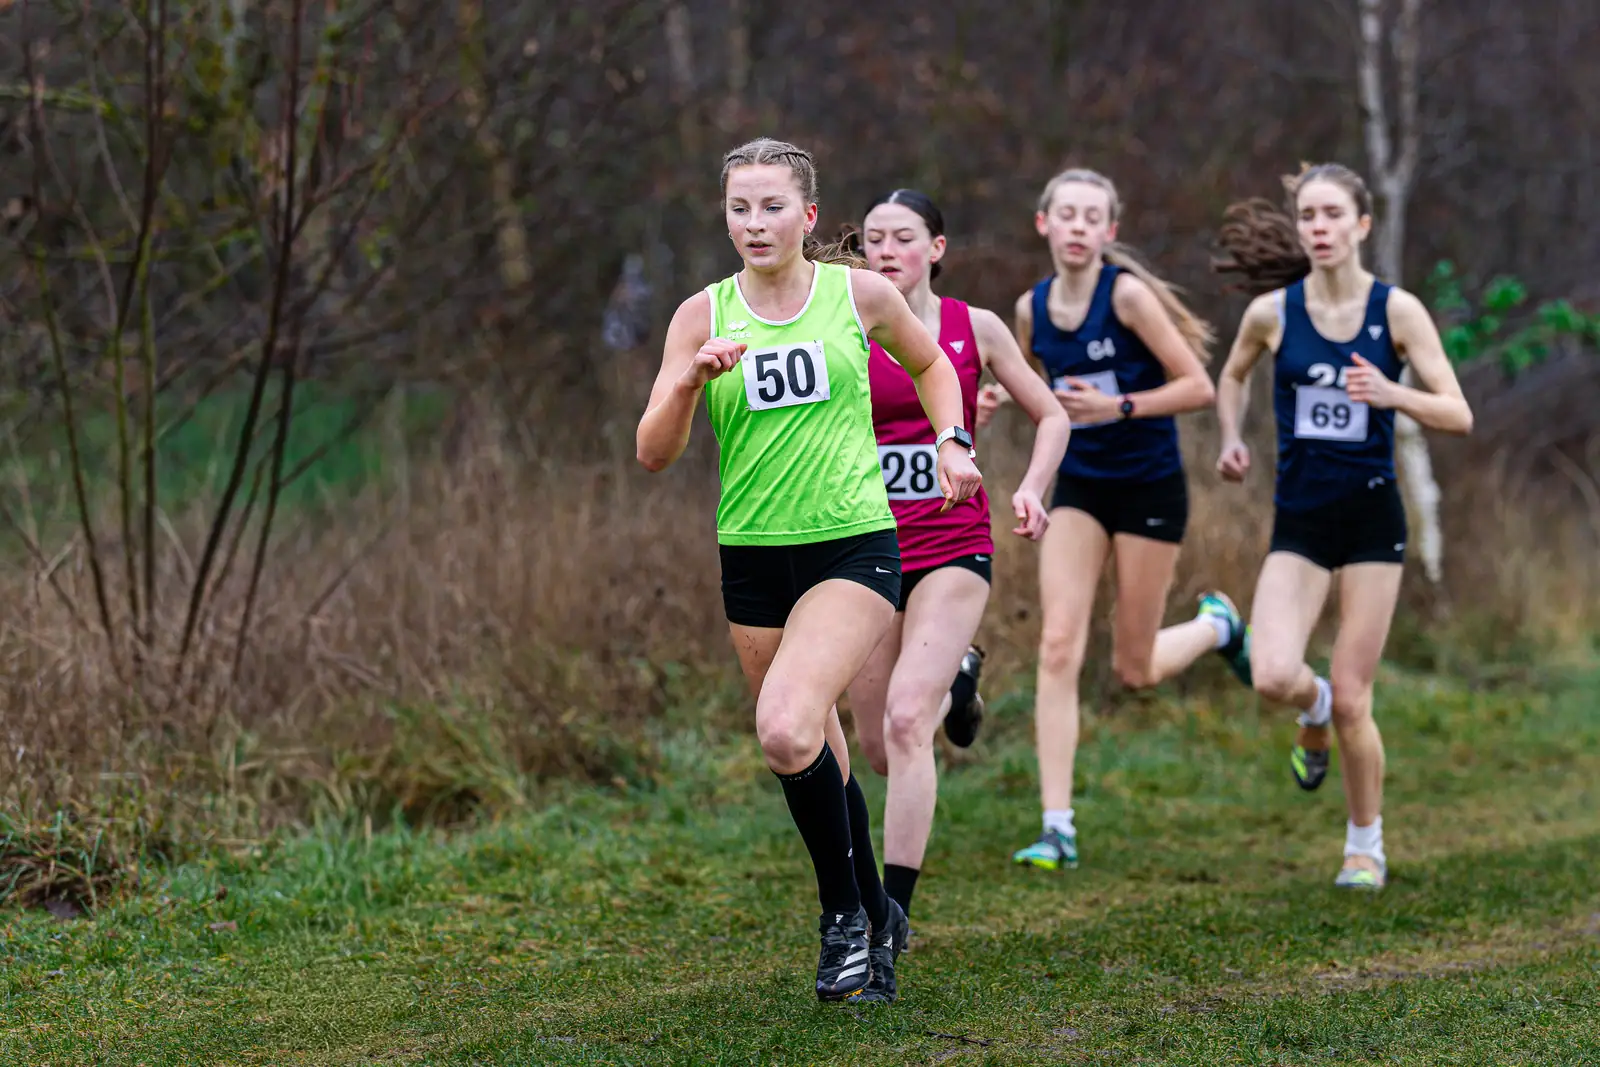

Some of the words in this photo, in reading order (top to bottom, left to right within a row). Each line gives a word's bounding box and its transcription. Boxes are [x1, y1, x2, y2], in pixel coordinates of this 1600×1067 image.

[755, 348, 816, 403] 50
[1310, 402, 1352, 430] 69
[881, 450, 934, 494] 28
